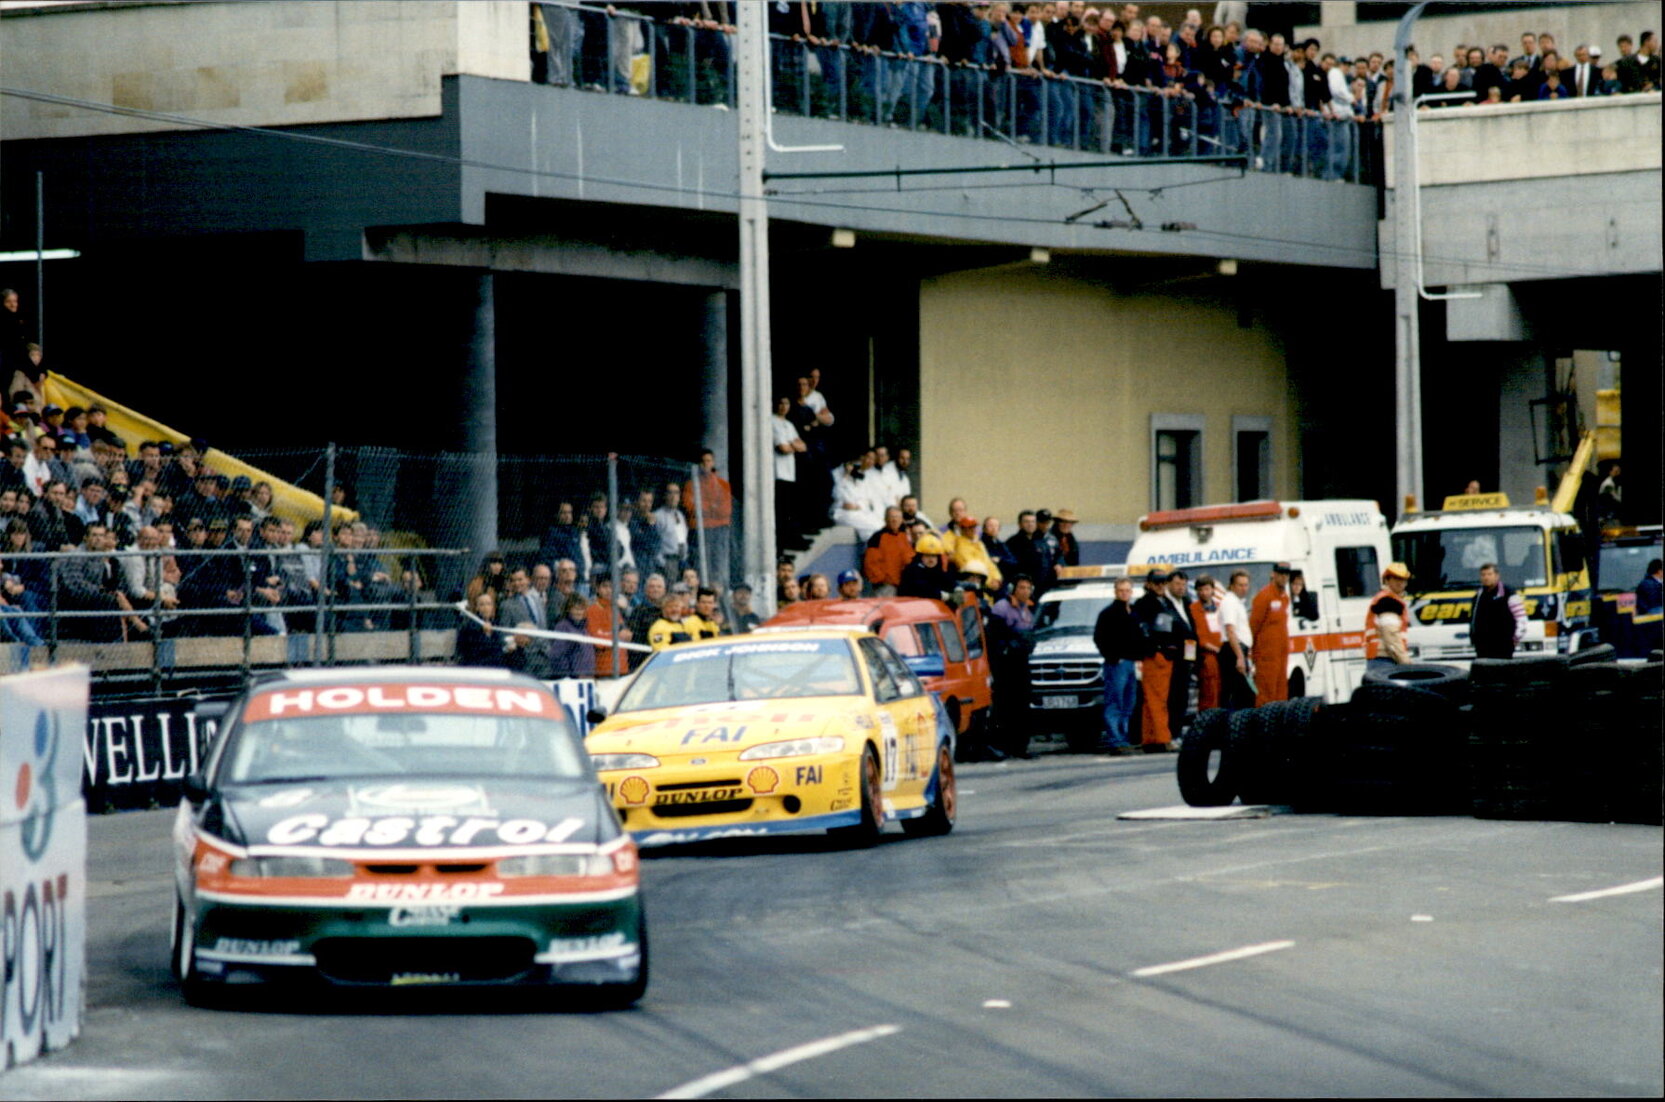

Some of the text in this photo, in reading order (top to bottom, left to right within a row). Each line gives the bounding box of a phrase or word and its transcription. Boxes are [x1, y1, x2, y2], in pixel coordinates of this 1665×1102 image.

[1146, 547, 1257, 565] AMBULANCE
[270, 686, 543, 714] HOLDEN
[680, 725, 748, 746] FAI
[884, 737, 897, 782] 17
[795, 765, 823, 786] FAI
[655, 788, 743, 805] DUNLOP
[267, 814, 587, 846] Castrol
[345, 883, 505, 899] DUNLOP
[214, 937, 300, 954] DUNLOP
